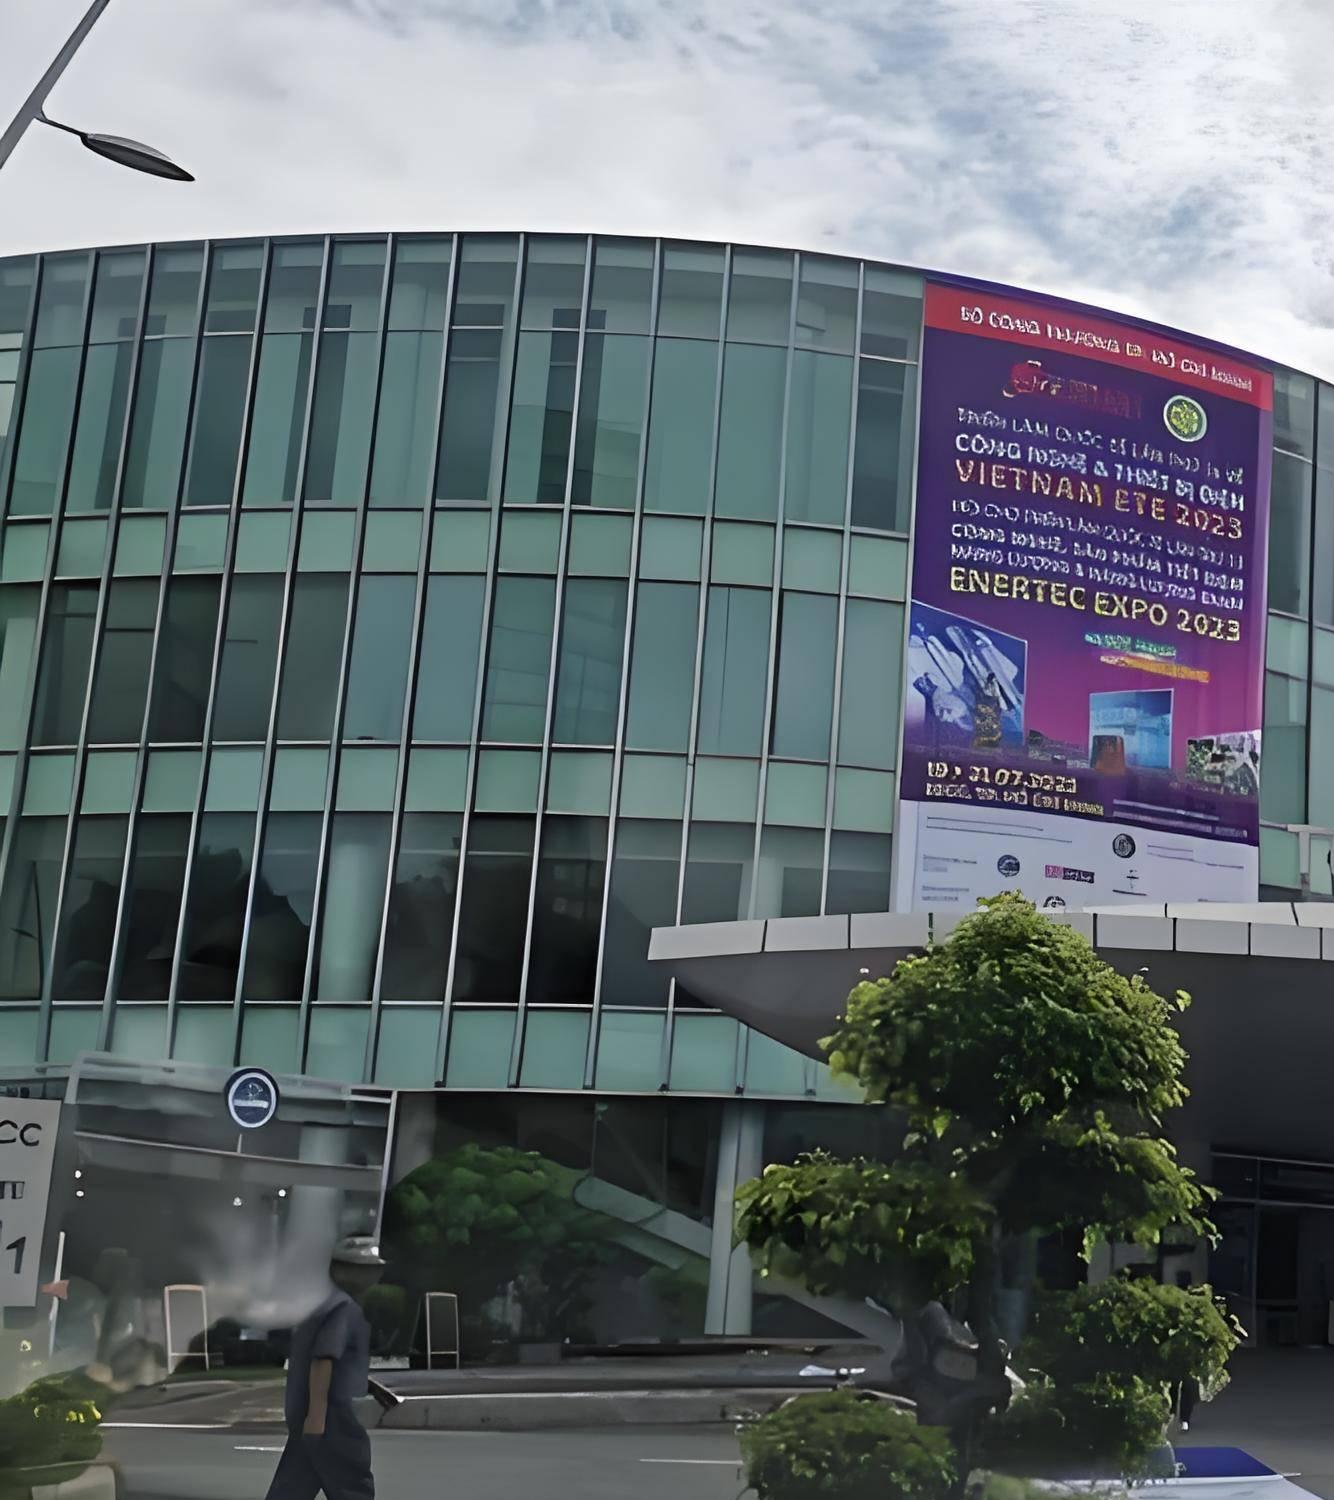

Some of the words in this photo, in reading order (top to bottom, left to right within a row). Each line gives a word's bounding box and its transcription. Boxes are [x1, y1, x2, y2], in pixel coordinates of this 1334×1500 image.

[955, 459, 1102, 506] VIETNAM
[950, 566, 1086, 610] ENERTEC
[1094, 592, 1168, 627] EXPO
